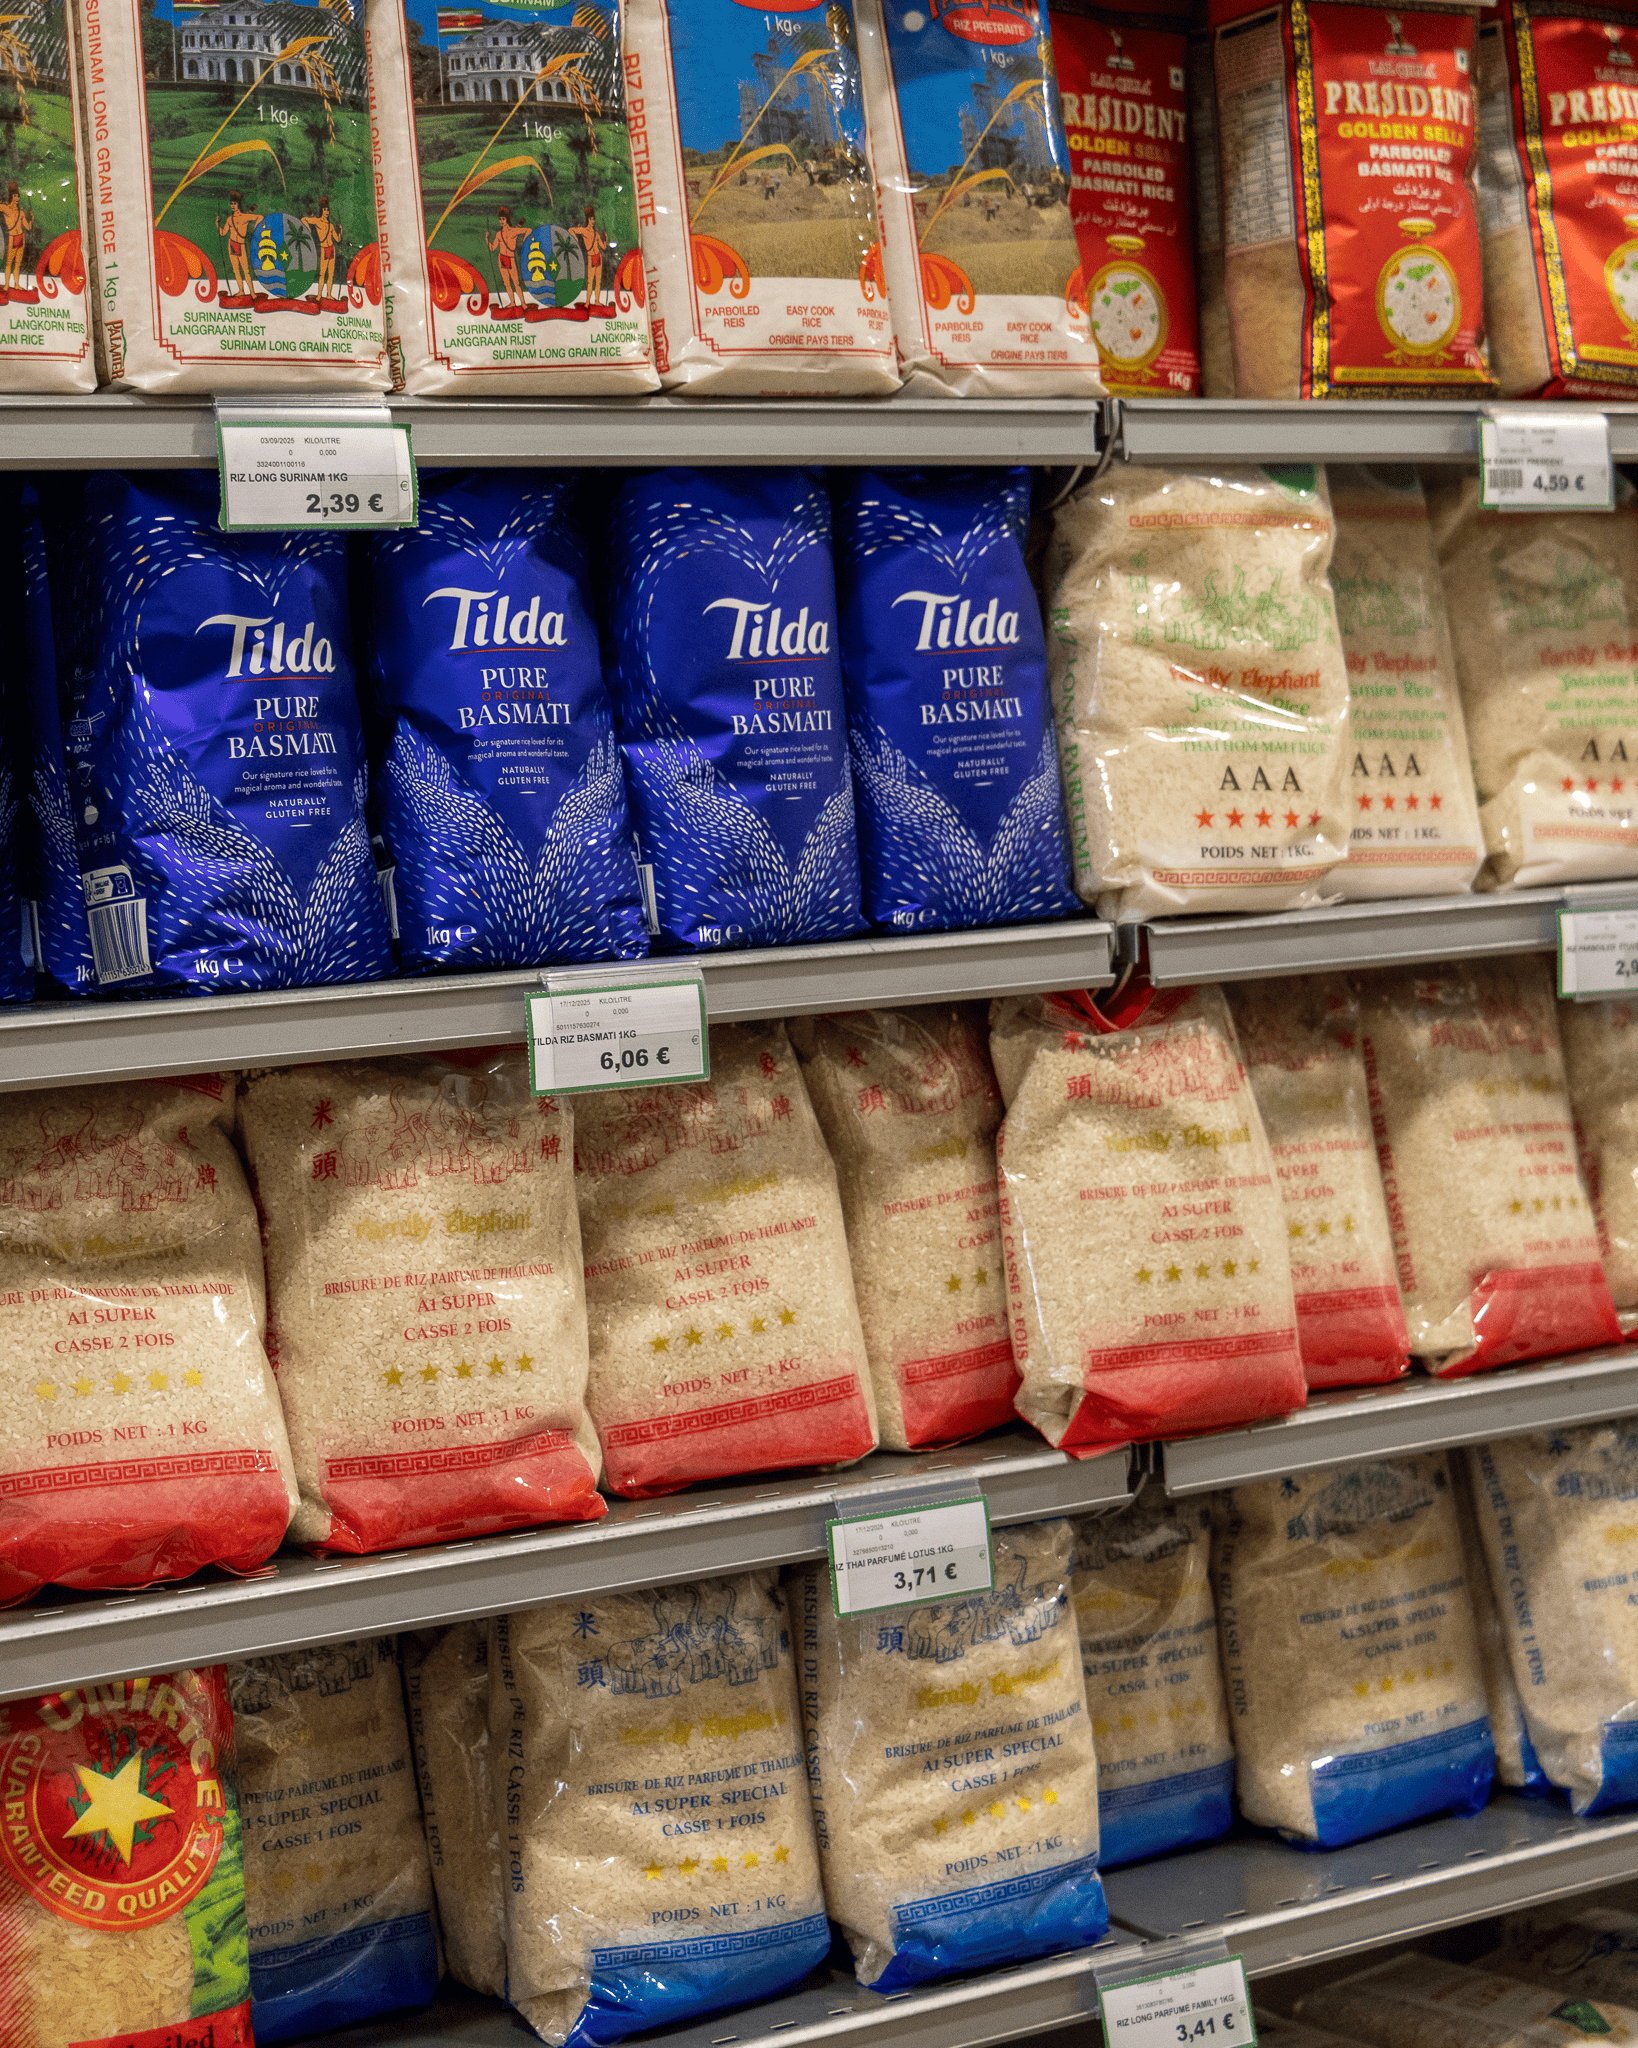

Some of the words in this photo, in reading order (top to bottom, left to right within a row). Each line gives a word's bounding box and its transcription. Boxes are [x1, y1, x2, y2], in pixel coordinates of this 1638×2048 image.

[954, 20, 970, 32] RIZ
[972, 21, 1026, 36] PRETRAITE
[1324, 81, 1472, 127] PRESIDENT
[90, 90, 108, 141] LONG
[1338, 122, 1418, 141] GOLDEN
[96, 148, 113, 205] GRAIN
[1358, 162, 1432, 178] BASMATI
[102, 210, 117, 255] RICE
[26, 307, 70, 319] SURINAM
[183, 312, 252, 324] SURINAAMSE
[705, 305, 760, 318] PARBOILED
[786, 306, 810, 316] EASY
[812, 306, 835, 316] COOK
[10, 319, 64, 331] LANGKORN
[66, 322, 85, 334] REIS
[170, 324, 236, 336] LANGGRAAN
[238, 325, 266, 336] RIJST
[336, 316, 372, 330] SURINAM
[456, 322, 523, 335] SURINAAMSE
[724, 317, 746, 328] REIS
[802, 317, 822, 328] RICE
[322, 328, 366, 341] LANGKORN
[443, 336, 510, 348] LANGGRAAN
[512, 335, 537, 346] RIJST
[769, 334, 804, 345] ORIGINE
[806, 336, 829, 346] PAYS
[831, 336, 854, 345] TIERS
[104, 320, 126, 381] PALMIER
[220, 339, 263, 352] SURINAM
[264, 340, 296, 352] LONG
[299, 341, 330, 352] GRAIN
[332, 342, 353, 354] RICE
[492, 349, 537, 360] SURINAM
[539, 348, 567, 359] LONG
[568, 348, 598, 358] GRAIN
[599, 346, 622, 357] RICE
[230, 474, 246, 482] RIZ
[248, 473, 277, 482] LONG
[280, 473, 325, 482] SURINAM
[328, 473, 348, 482] 1KG
[1533, 475, 1568, 492] 4,59
[1575, 475, 1584, 490] €
[306, 494, 360, 518] 2,39
[368, 494, 384, 513] €
[422, 588, 568, 651] Tilda
[703, 598, 829, 659] Tilda
[891, 591, 1020, 651] Tilda
[194, 615, 336, 677] Tilda
[481, 668, 549, 690] PURE
[753, 676, 814, 700] PURE
[942, 665, 1003, 689] PURE
[482, 691, 551, 701] ORIGINAL
[254, 697, 319, 720] PURE
[457, 703, 571, 729] BASMATI
[920, 697, 1022, 726] BASMATI
[732, 710, 832, 736] BASMATI
[228, 734, 337, 759] BASMATI
[474, 738, 488, 747] Our
[491, 737, 520, 749] signature
[468, 751, 493, 762] magical
[495, 750, 516, 759] aroma
[498, 776, 530, 785] GLUTEN
[533, 775, 549, 784] FREE
[502, 766, 545, 775] NATURALLY
[1220, 765, 1241, 792] A
[1250, 766, 1272, 792] A
[1282, 766, 1303, 792] A
[265, 808, 307, 818] GLUTEN
[309, 807, 331, 816] FREE
[1200, 846, 1244, 859] POIDS
[1251, 846, 1277, 859] NET
[600, 996, 632, 1004] KILO/LITRE
[531, 1037, 558, 1047] TILDA
[560, 1036, 574, 1044] RIZ
[577, 1032, 616, 1042] BASMATI
[619, 1030, 636, 1039] 1KG
[600, 1049, 648, 1073] 6,06
[656, 1047, 670, 1064] €
[695, 1254, 752, 1278] SUPER
[324, 1280, 379, 1295] BRISURE
[384, 1277, 401, 1289] DE
[404, 1274, 427, 1287] RIZ
[431, 1270, 480, 1285] PARFUME
[484, 1269, 496, 1280] DE
[499, 1263, 554, 1278] THAILANDE
[442, 1292, 496, 1310] SUPER
[665, 1290, 715, 1310] CASSE
[732, 1278, 770, 1298] FOIS
[67, 1309, 91, 1325] A1
[94, 1306, 156, 1325] SUPER
[404, 1323, 459, 1341] CASSE
[478, 1318, 511, 1333] FOIS
[55, 1336, 114, 1355] CASSE
[119, 1336, 129, 1349] 2
[134, 1332, 175, 1349] FOIS
[46, 1429, 102, 1448] POIDS
[114, 1425, 146, 1440] NET
[183, 1420, 208, 1435] KG
[392, 1417, 445, 1434] POIDS
[455, 1412, 485, 1426] NET
[846, 1560, 865, 1569] THAI
[867, 1552, 906, 1566] PARFUMÉ
[908, 1548, 935, 1559] LOTUS
[938, 1545, 953, 1554] 1KG
[894, 1566, 936, 1591] 3,71
[945, 1563, 957, 1579] €
[944, 1749, 994, 1770] SUPER
[1004, 1734, 1064, 1756] SPECIAL
[588, 1779, 639, 1796] BRISURE
[688, 1768, 739, 1784] PARFUME
[952, 1773, 997, 1792] CASSE
[655, 1794, 711, 1813] SUPER
[721, 1783, 787, 1805] SPECIAL
[5, 1734, 106, 1912] GUARANTEED
[117, 1829, 212, 1917] QUALITY
[662, 1819, 711, 1838] CASSE
[730, 1812, 766, 1827] FOIS
[945, 1855, 989, 1875] POIDS
[996, 1846, 1022, 1864] NET
[652, 1907, 700, 1924] POIDS
[710, 1903, 738, 1918] NET
[1116, 2019, 1129, 2027] RIZ
[1131, 2013, 1152, 2024] LONG
[1154, 2004, 1190, 2019] PARFUMÉ
[1192, 1998, 1217, 2011] FAMILY
[1220, 1994, 1234, 2003] 1KG
[1176, 2018, 1215, 2042] 3,41
[1223, 2014, 1234, 2030] €
